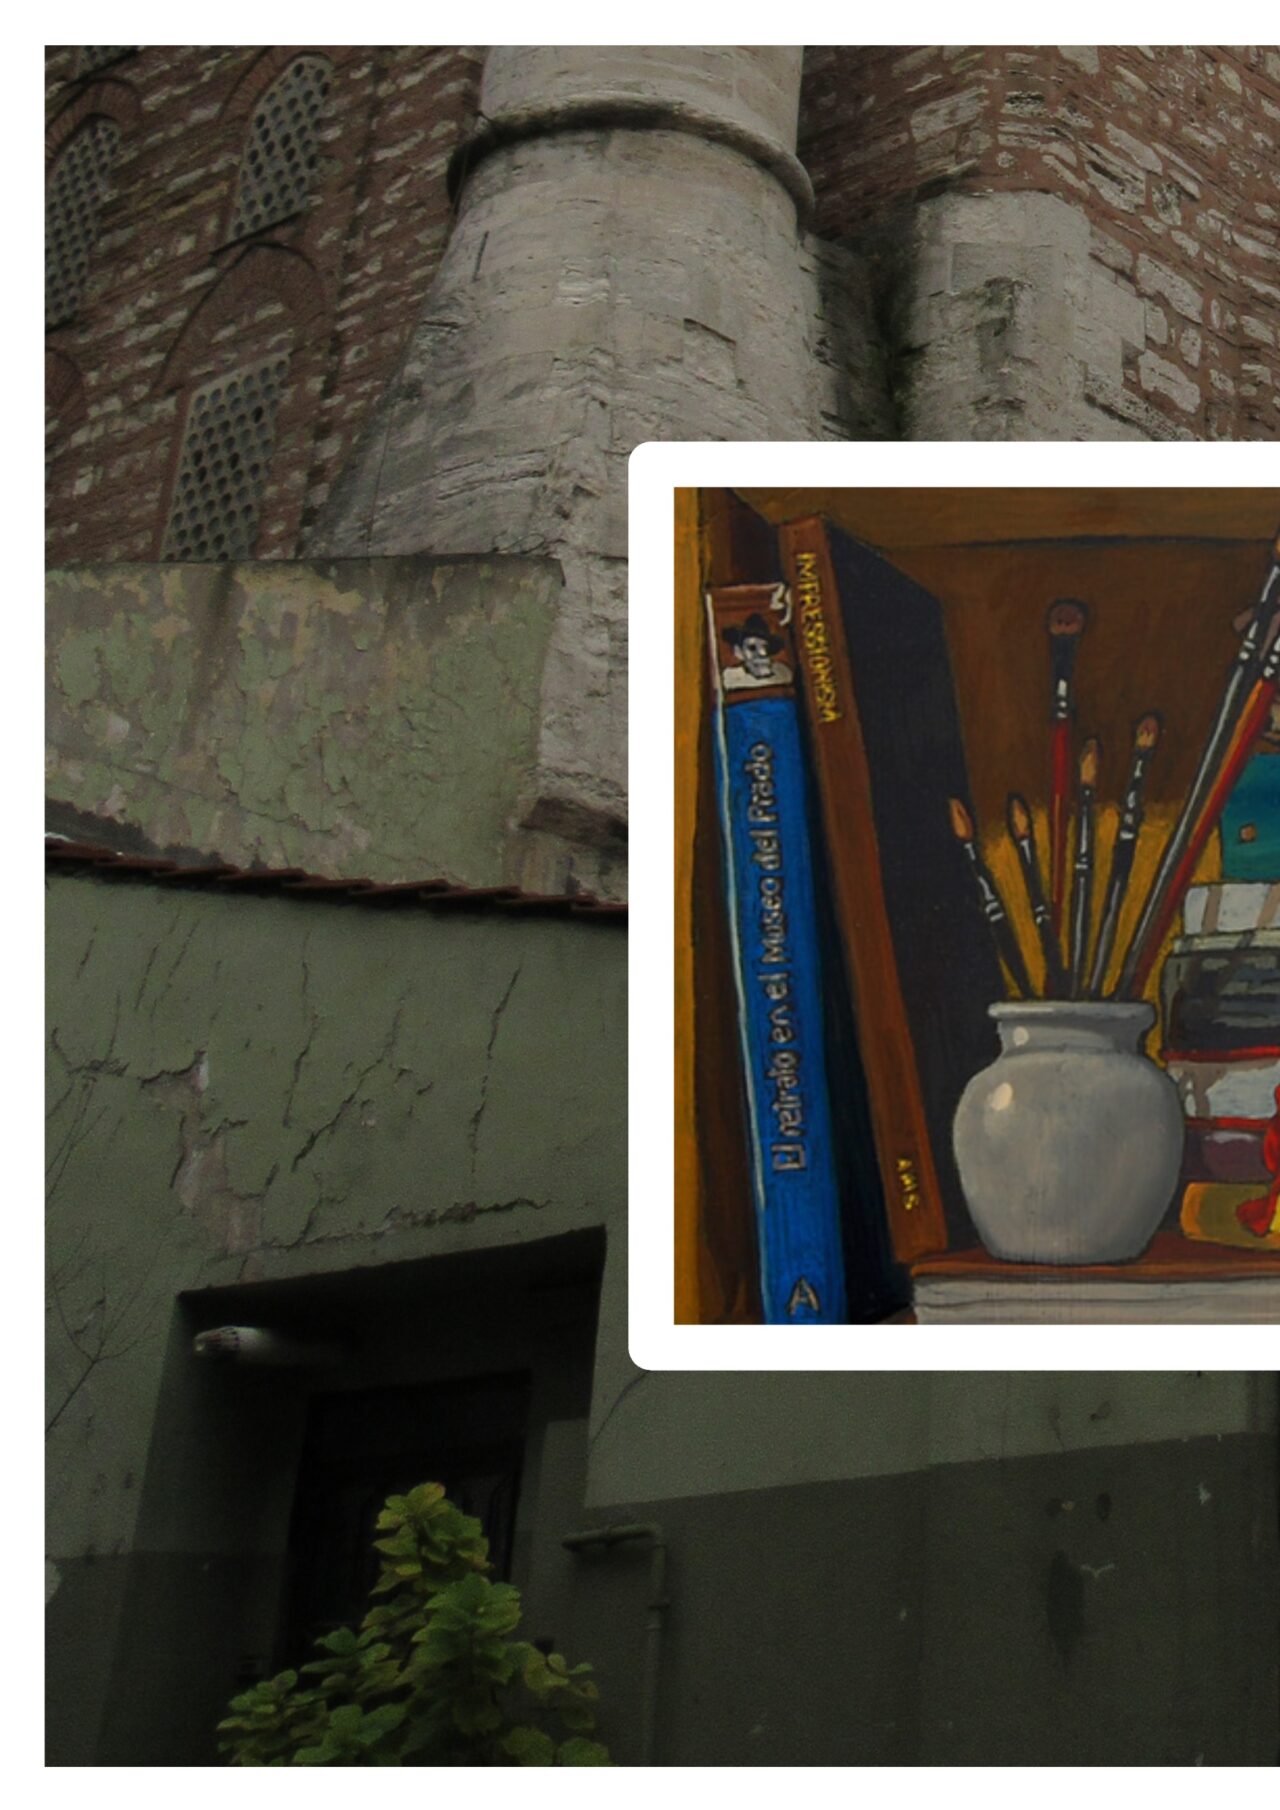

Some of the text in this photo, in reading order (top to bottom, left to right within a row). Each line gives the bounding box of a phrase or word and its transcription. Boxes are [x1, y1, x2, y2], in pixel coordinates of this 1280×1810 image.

[744, 743, 807, 1172] El retrato en el Museo del Prado
[786, 1277, 821, 1316] A
